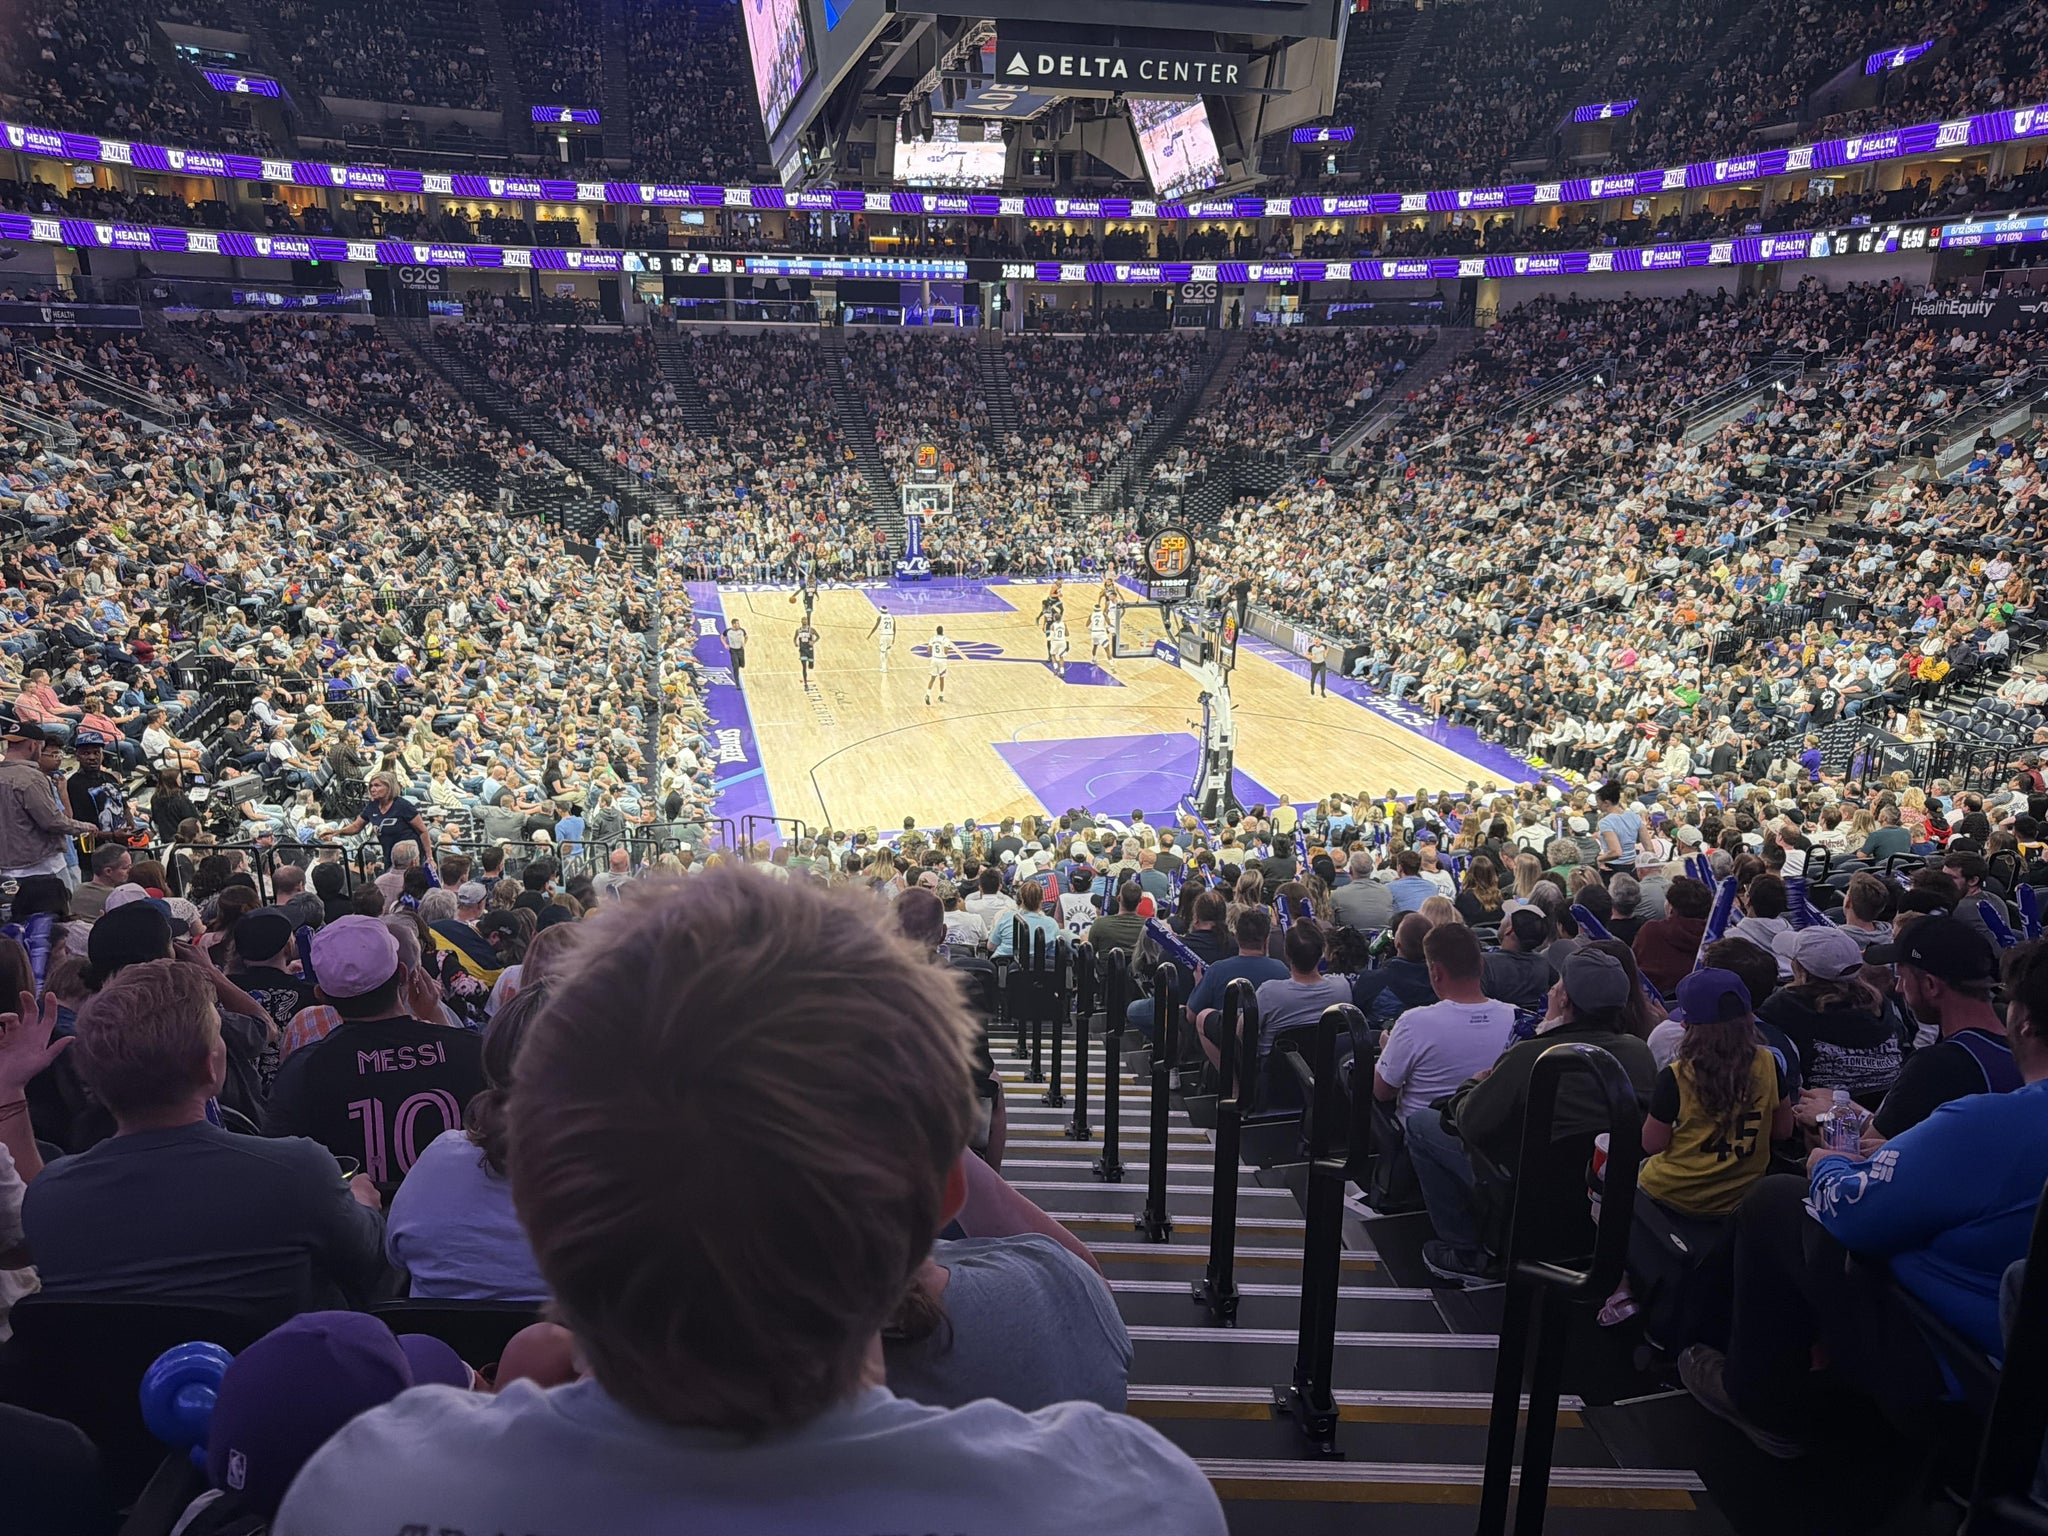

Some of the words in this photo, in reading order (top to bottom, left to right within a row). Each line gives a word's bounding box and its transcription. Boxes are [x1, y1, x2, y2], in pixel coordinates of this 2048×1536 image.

[1037, 54, 1128, 78] DELTA
[1140, 60, 1238, 84] CENTER
[26, 132, 61, 147] HEALTH
[1863, 136, 1897, 151] HEALTH
[186, 156, 223, 169] HEALTH
[1727, 160, 1756, 174] HEALTH
[348, 171, 384, 183] HEALTH
[506, 182, 540, 193] HEALTH
[1604, 179, 1634, 190] HEALTH
[656, 188, 689, 199] HEALTH
[800, 194, 831, 204] HEALTH
[1473, 191, 1503, 202] HEALTH
[938, 198, 968, 208] HEALTH
[1069, 201, 1099, 212] HEALTH
[1203, 203, 1233, 213] HEALTH
[1338, 199, 1368, 210] HEALTH
[1951, 226, 1964, 235] 6/12
[1995, 222, 2007, 231] 3/5
[115, 230, 150, 242] HEALTH
[1931, 228, 1940, 237] 21
[1996, 233, 2007, 242] 0/1
[1858, 235, 1871, 252] 16
[1902, 229, 1925, 249] 5:59
[1929, 238, 1939, 247] 1ST
[1949, 237, 1962, 246] 8/15
[273, 241, 309, 252] HEALTH
[1775, 238, 1806, 253] HEALTH
[1835, 237, 1848, 253] 15
[431, 250, 465, 260] HEALTH
[583, 255, 616, 266] HEALTH
[1654, 250, 1681, 262] HEALTH
[648, 257, 661, 271] 15
[671, 258, 684, 272] 16
[1529, 258, 1559, 268] HEALTH
[1002, 264, 1019, 278] 7:52
[1021, 265, 1034, 278] PM
[1131, 267, 1160, 277] HEALTH
[1263, 267, 1293, 277] HEALTH
[1397, 264, 1427, 274] HEALTH
[399, 266, 440, 284] G2G
[1181, 282, 1217, 299] G2G
[1911, 301, 1993, 318] HealthEquity
[1161, 537, 1185, 550] 5:58
[1156, 549, 1183, 571] 21
[1161, 579, 1189, 587] TISSOT
[884, 621, 892, 629] 21
[1057, 630, 1062, 638] 0
[935, 645, 940, 653] 5
[1822, 699, 1834, 710] 23
[1375, 699, 1434, 727] PACS
[1193, 748, 1204, 791] AMERICA
[357, 1041, 446, 1075] MESSI
[348, 1088, 462, 1183] 10
[1700, 1111, 1762, 1163] 45
